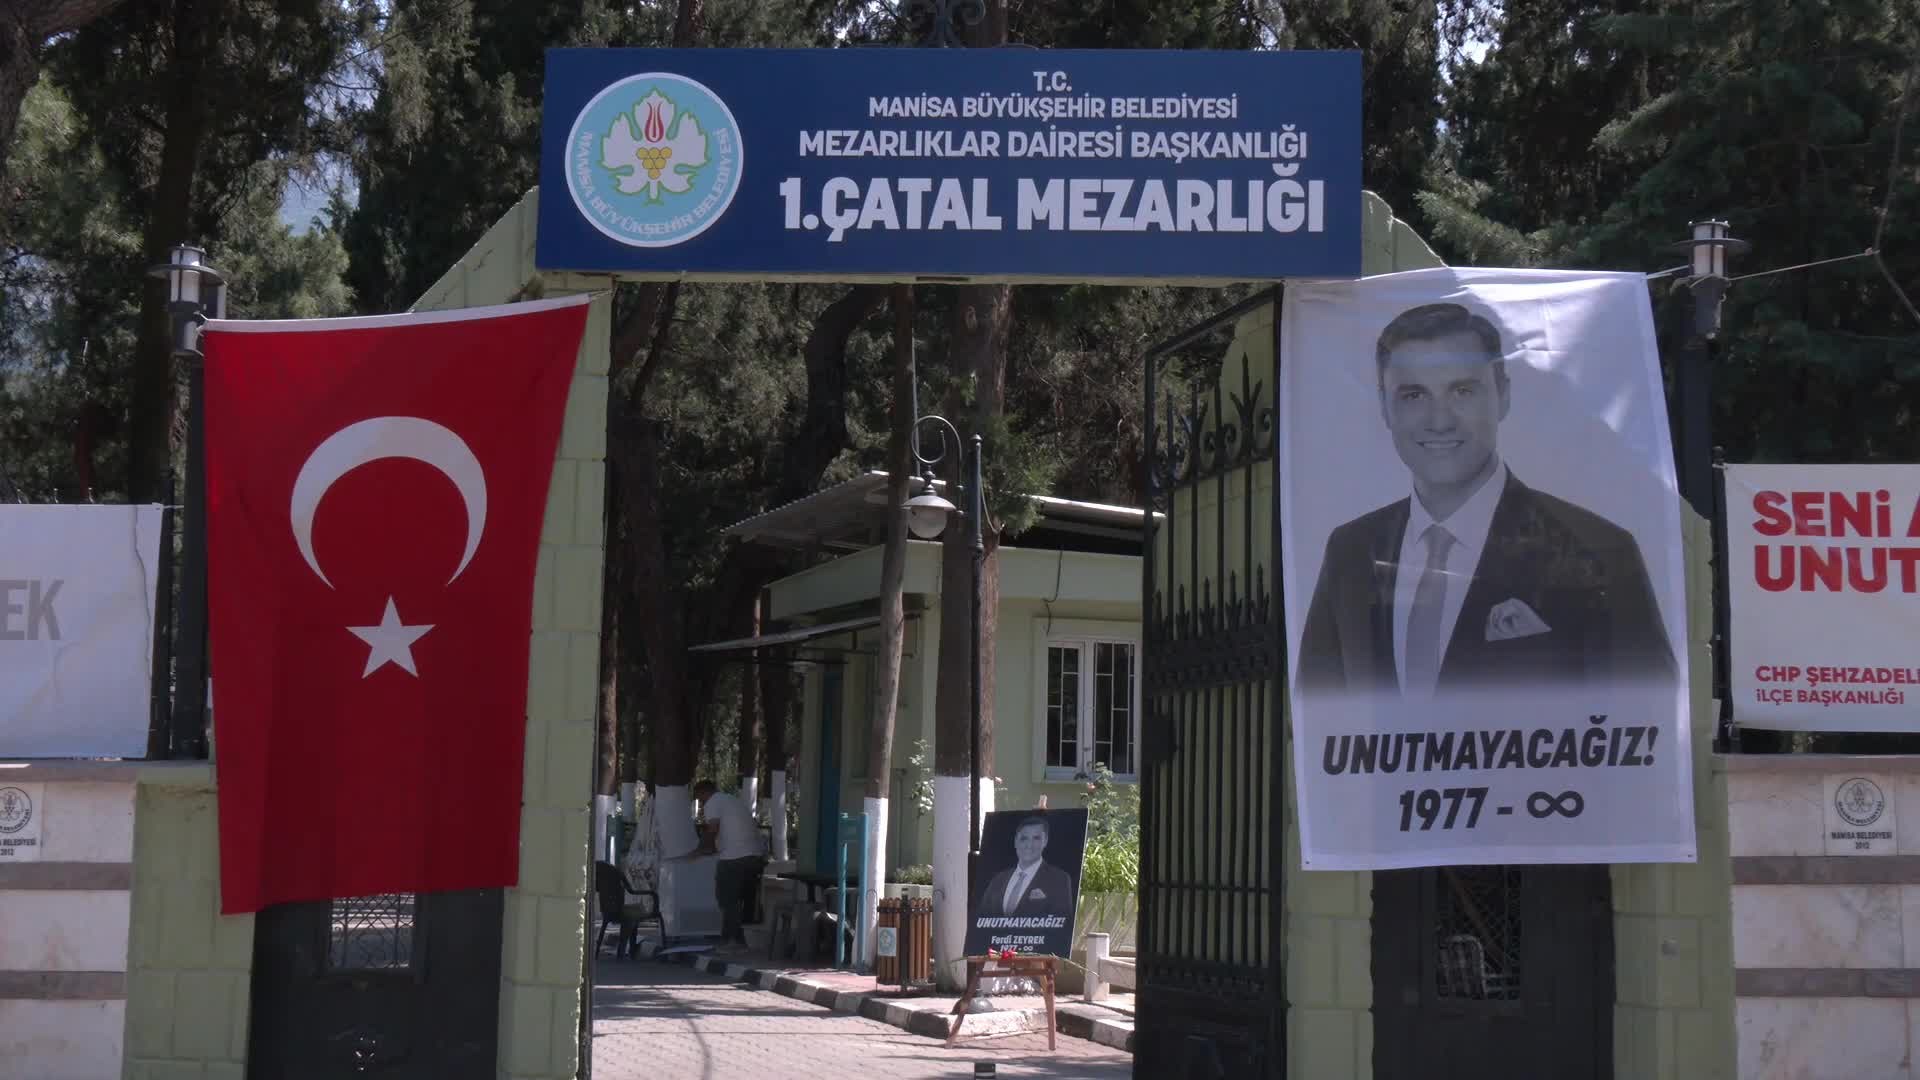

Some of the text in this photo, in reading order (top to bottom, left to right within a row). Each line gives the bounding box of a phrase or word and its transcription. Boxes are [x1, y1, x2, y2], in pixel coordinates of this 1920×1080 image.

[1033, 71, 1073, 92] T.C.
[869, 92, 1238, 121] MANİSA BÜYÜKŞEHİR BELEDİYESİ
[799, 124, 1308, 164] MEZARLIKLAR DAİRESİ BAŞKANLIĞI
[780, 163, 1325, 242] 1.ÇATAL MEZARLIĞI
[1754, 545, 1920, 594] UNUT
[1755, 665, 1801, 683] CHP
[1797, 687, 1905, 708] BAŞKANLIĞI
[1322, 714, 1659, 776] UNUTMAYACAĞIZ!
[1400, 786, 1490, 833] 1977
[976, 914, 1067, 929] UNUTMAYACAĞIZ!
[991, 935, 1045, 945] Ferdi ZEYREK
